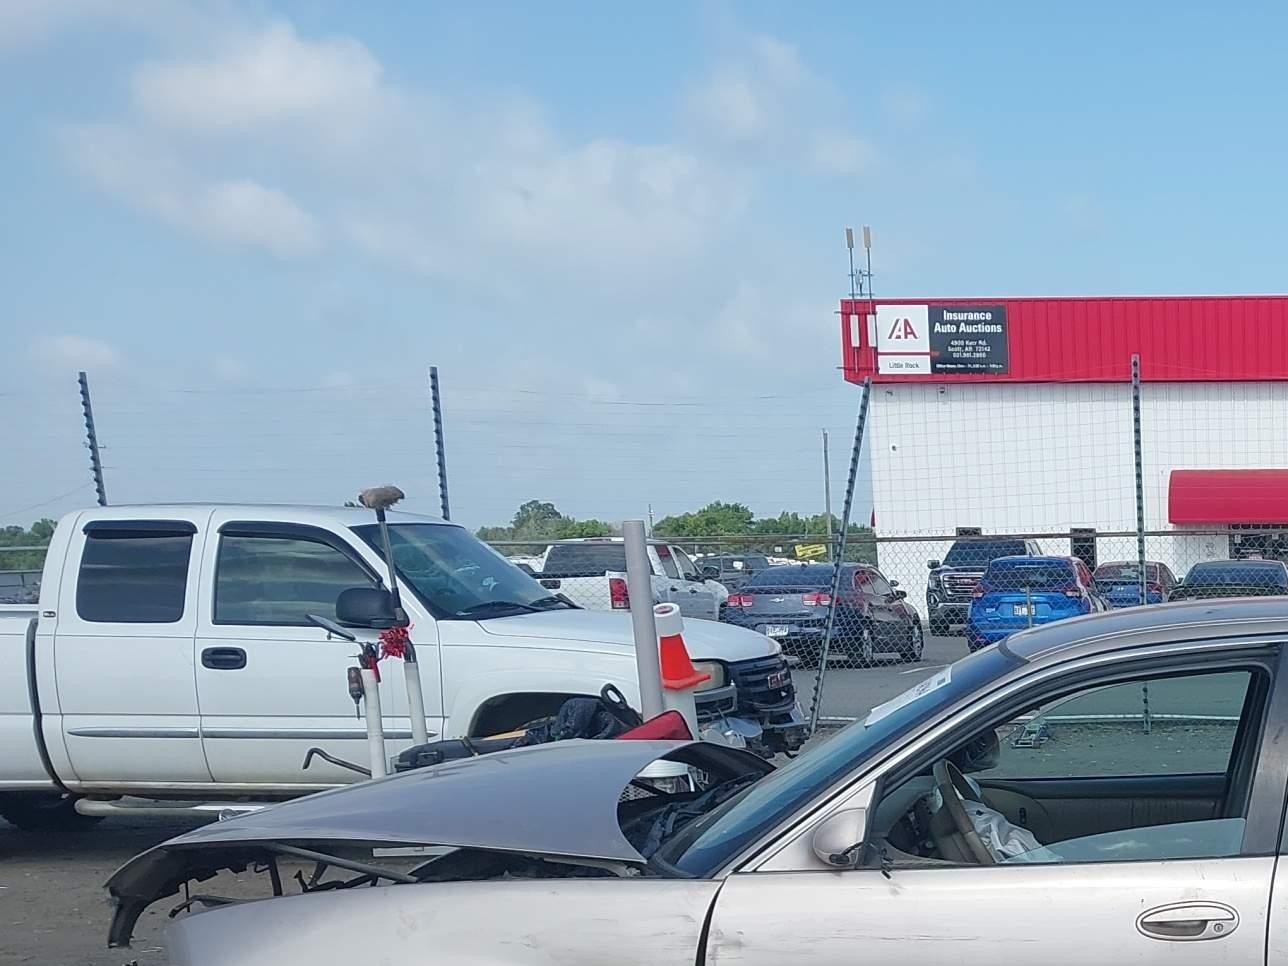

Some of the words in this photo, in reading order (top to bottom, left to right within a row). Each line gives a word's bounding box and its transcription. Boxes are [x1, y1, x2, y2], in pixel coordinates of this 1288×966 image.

[943, 310, 992, 321] Insurance
[934, 322, 957, 333] Auto
[959, 322, 1002, 333] Auctions
